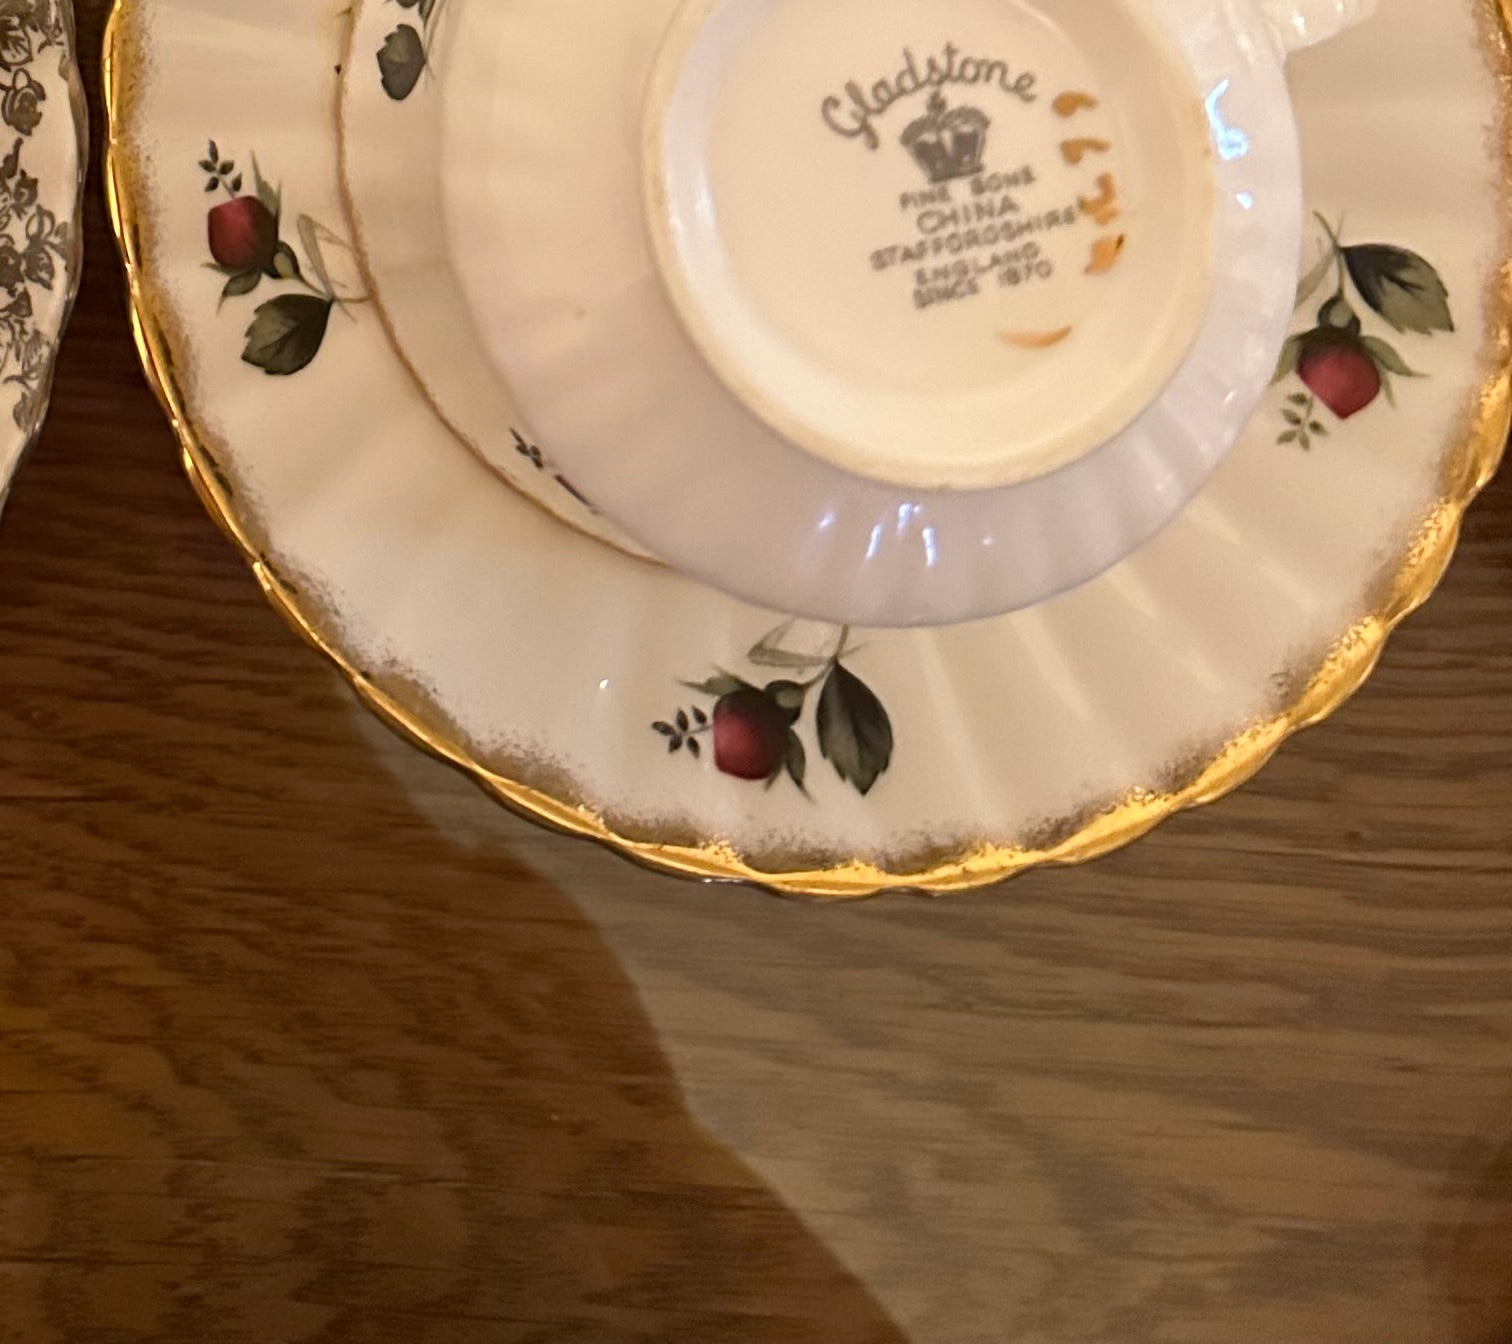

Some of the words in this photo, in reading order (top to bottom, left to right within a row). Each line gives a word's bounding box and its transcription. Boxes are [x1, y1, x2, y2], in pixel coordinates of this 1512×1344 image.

[821, 41, 1037, 150] Gladstone
[899, 186, 951, 210] FINE
[916, 196, 1020, 235] CHINA
[869, 206, 1078, 271] STAFFORDSHIRE
[914, 241, 1041, 286] ENGLAND
